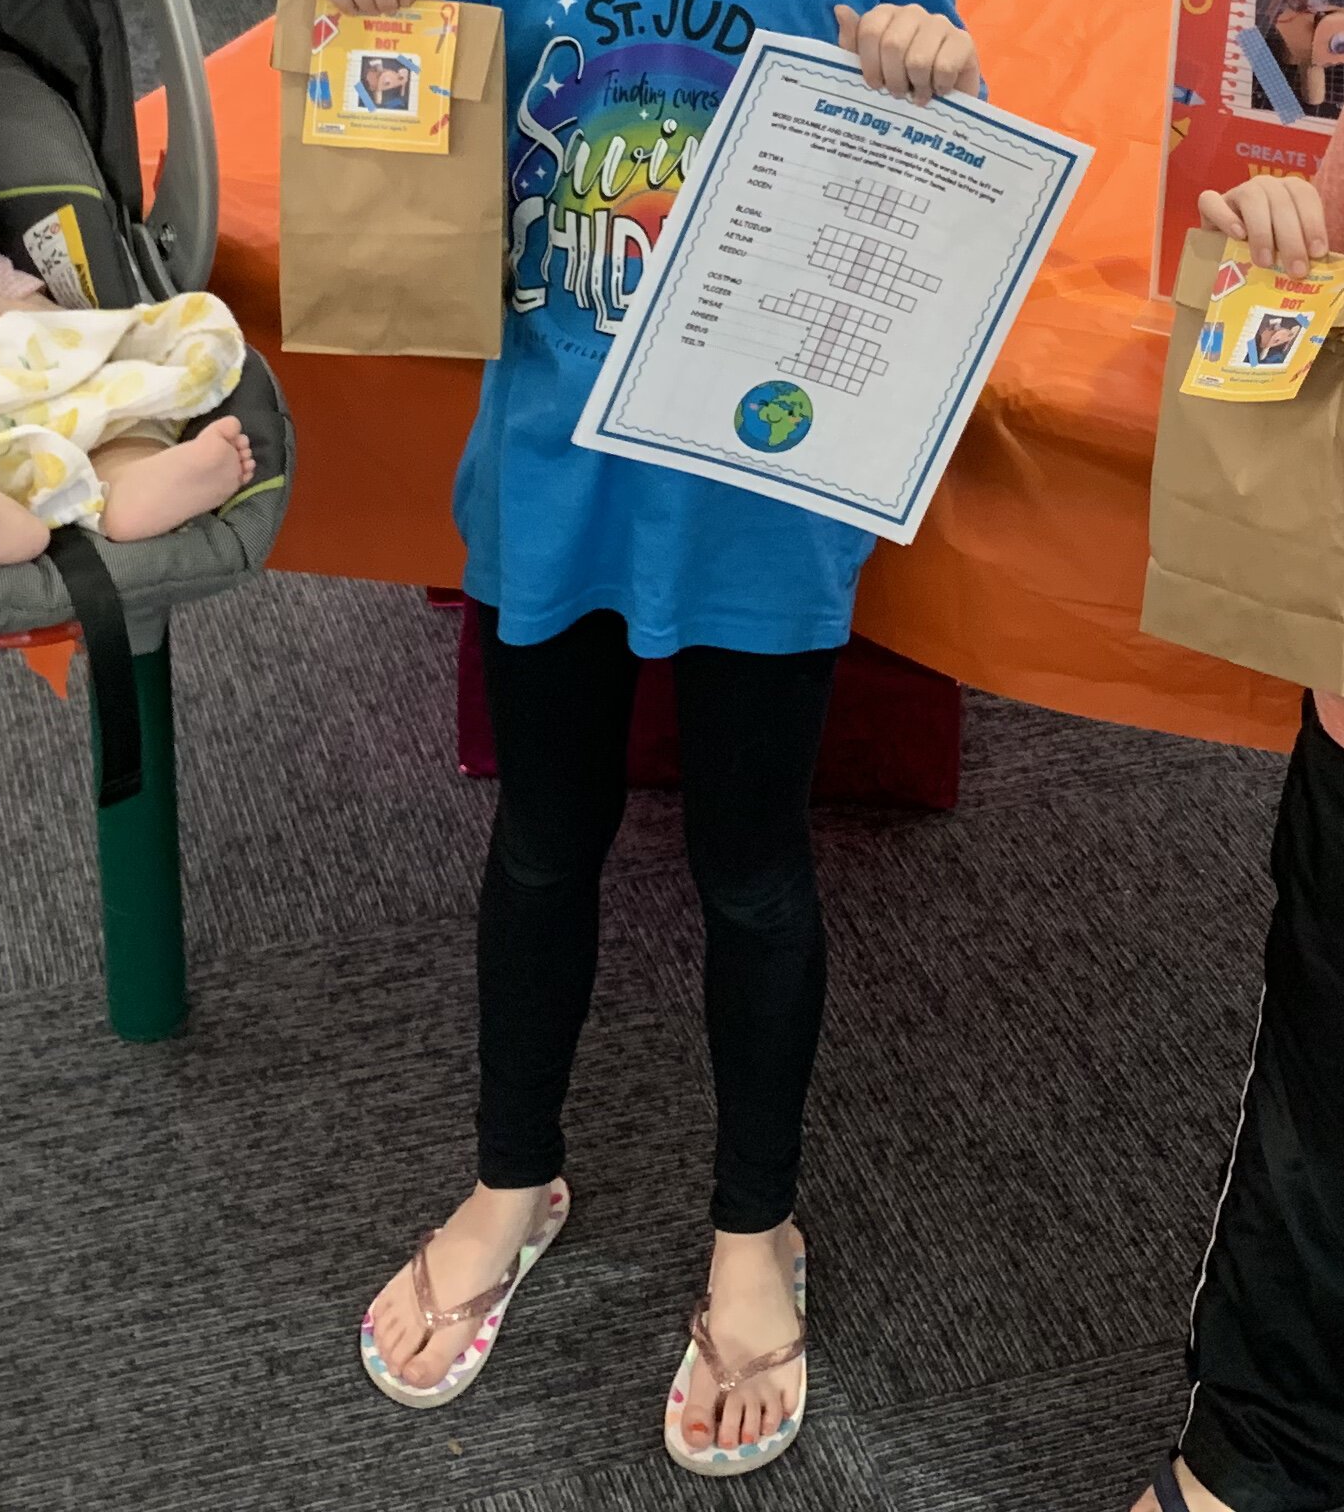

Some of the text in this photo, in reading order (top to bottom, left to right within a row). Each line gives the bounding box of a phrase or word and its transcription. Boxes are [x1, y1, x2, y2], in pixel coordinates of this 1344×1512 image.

[363, 19, 414, 35] WOBBLE
[375, 37, 400, 50] BOT
[603, 69, 665, 120] Finding
[814, 98, 859, 123] Earth
[859, 111, 891, 136] Day
[901, 125, 943, 150] April
[942, 141, 986, 168] 22nd
[1235, 142, 1307, 168] CREATE
[511, 195, 654, 336] CHILD
[1274, 276, 1324, 295] WOBBLE
[1280, 297, 1305, 310] BOT
